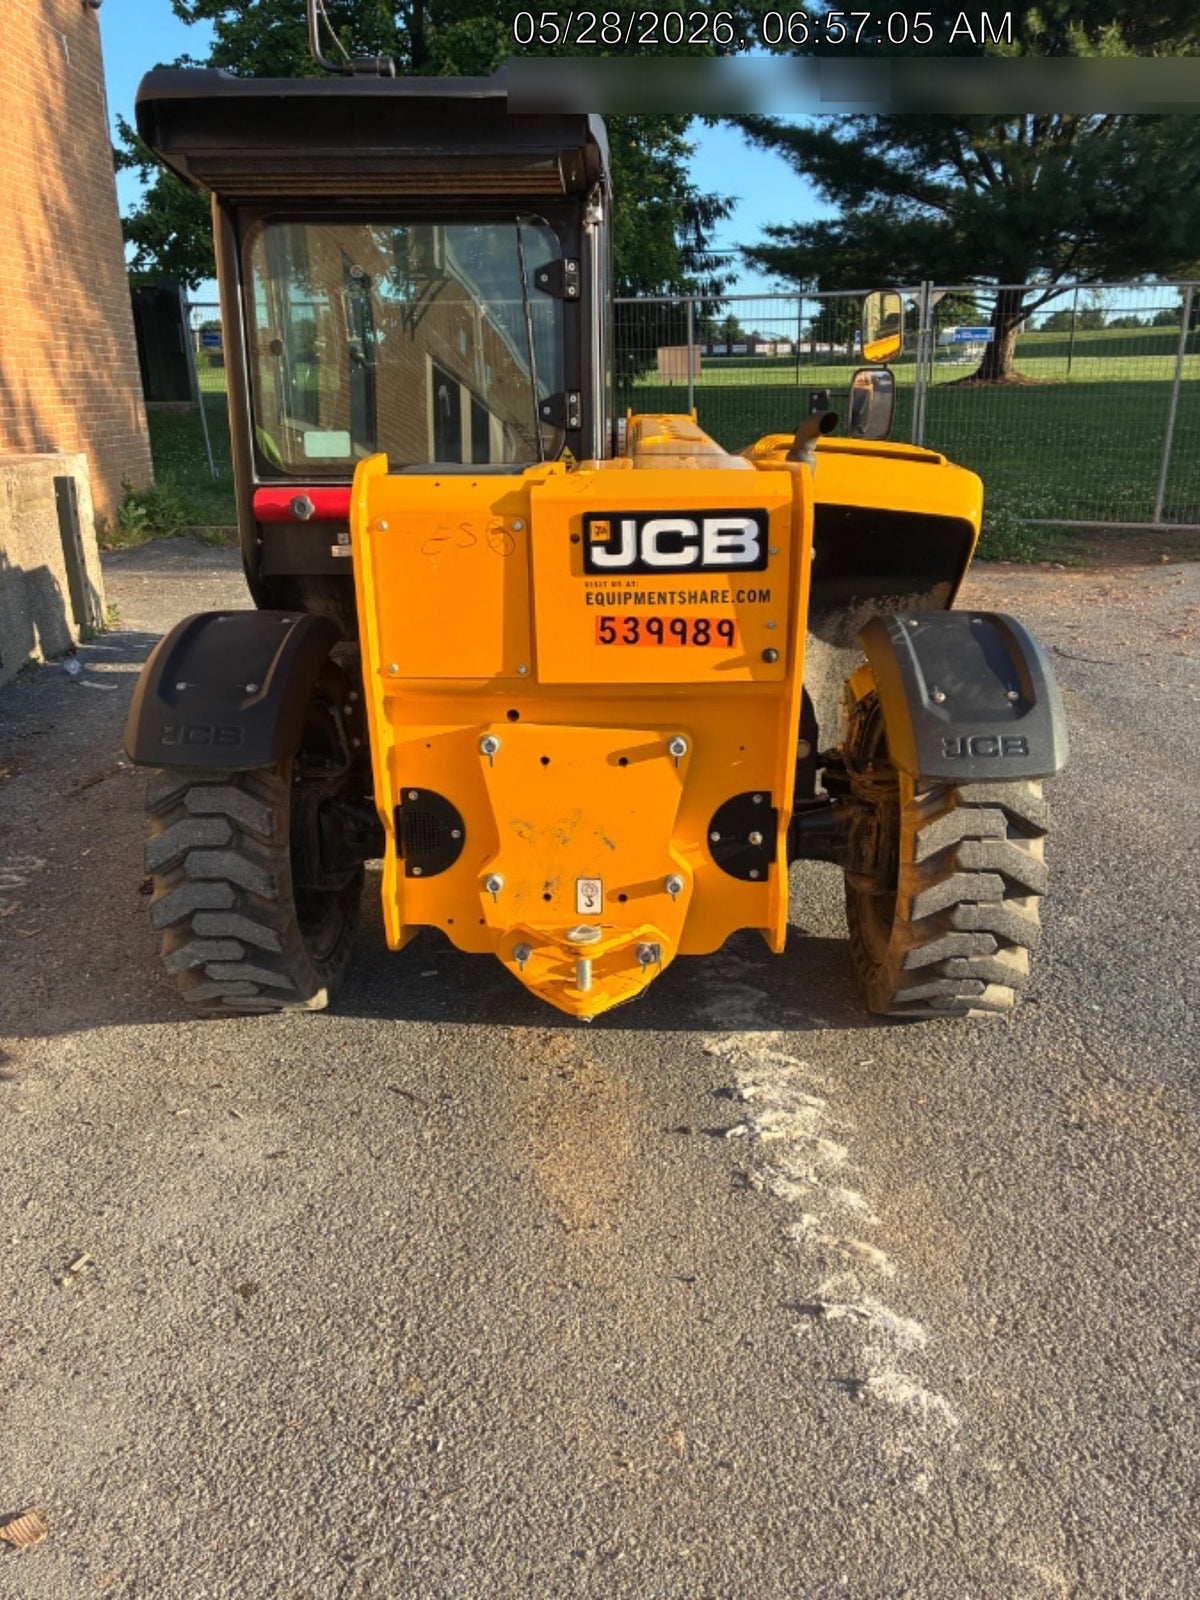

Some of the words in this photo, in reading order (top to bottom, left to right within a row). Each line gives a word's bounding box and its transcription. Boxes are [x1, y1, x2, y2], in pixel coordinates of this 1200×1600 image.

[589, 517, 761, 567] JCB
[584, 580, 608, 588] VISIT
[611, 580, 623, 588] US
[626, 580, 639, 588] AT:
[585, 588, 772, 607] EQUIPMENTSHARE.COM
[598, 616, 736, 647] 539989
[160, 723, 246, 747] JCB
[941, 734, 1030, 760] JCB
